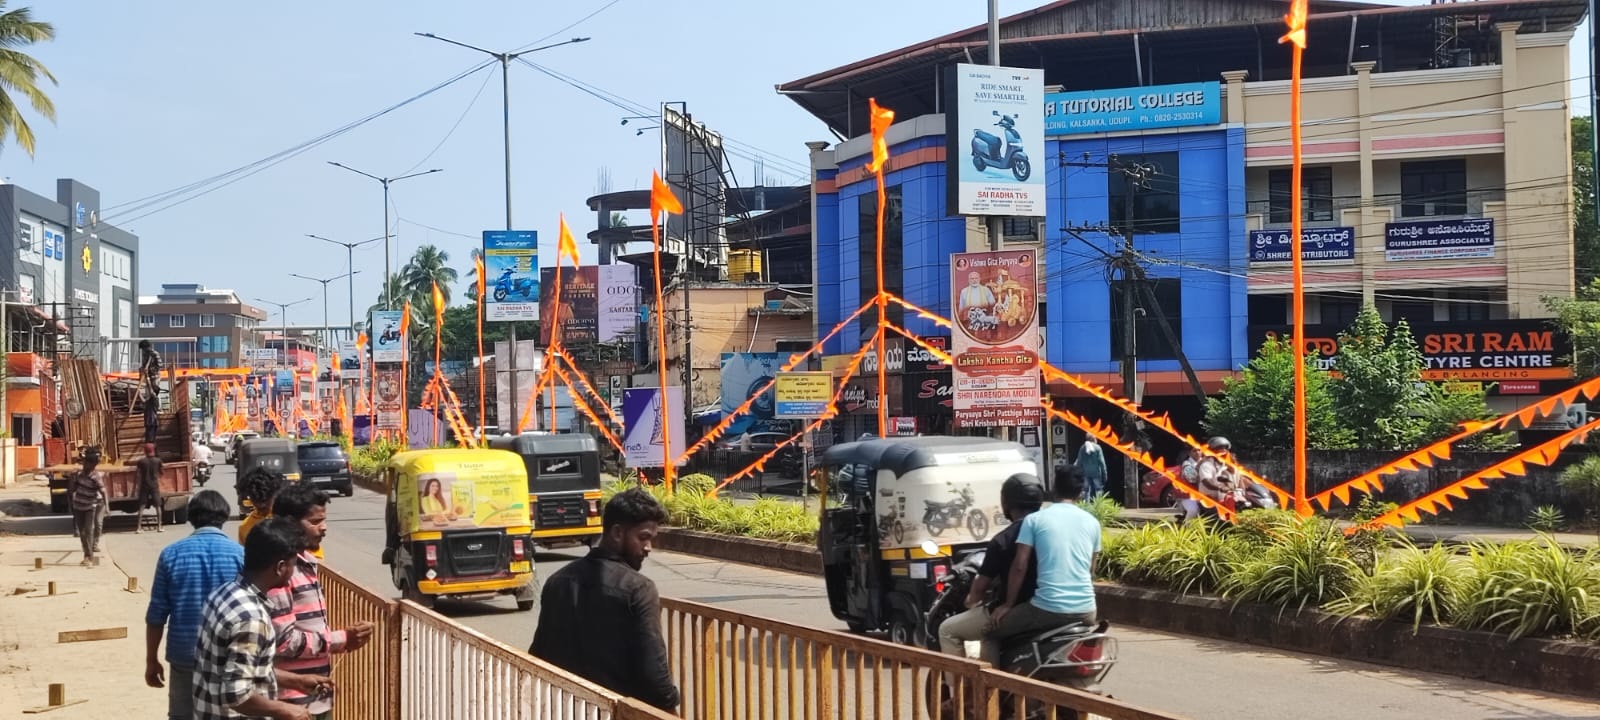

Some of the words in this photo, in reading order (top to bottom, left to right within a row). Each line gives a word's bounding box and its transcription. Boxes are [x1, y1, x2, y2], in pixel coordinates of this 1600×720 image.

[980, 83, 997, 91] RIDE
[1044, 101, 1056, 117] A
[1061, 96, 1135, 115] TUTORIAL
[1138, 91, 1204, 109] COLLEGE
[1154, 112, 1203, 122] 0820-2530314
[990, 191, 1014, 199] RADHA
[1389, 239, 1438, 247] GURUSHREE
[1439, 237, 1490, 246] ASSOCIATES
[1266, 251, 1292, 259] SHREE
[1301, 249, 1349, 258] STRIBUTORS
[1424, 332, 1475, 353] SRI
[1481, 331, 1553, 352] RAM
[958, 357, 984, 366] Laksha
[986, 356, 1013, 366] Kantha
[1015, 355, 1033, 364] Gita
[1425, 356, 1472, 368] TYRE
[1479, 355, 1552, 367] CENTRE
[1443, 370, 1529, 378] BALANCING
[974, 391, 1011, 399] NARENDRA
[983, 409, 996, 417] Shri
[974, 419, 998, 427] Krishna
